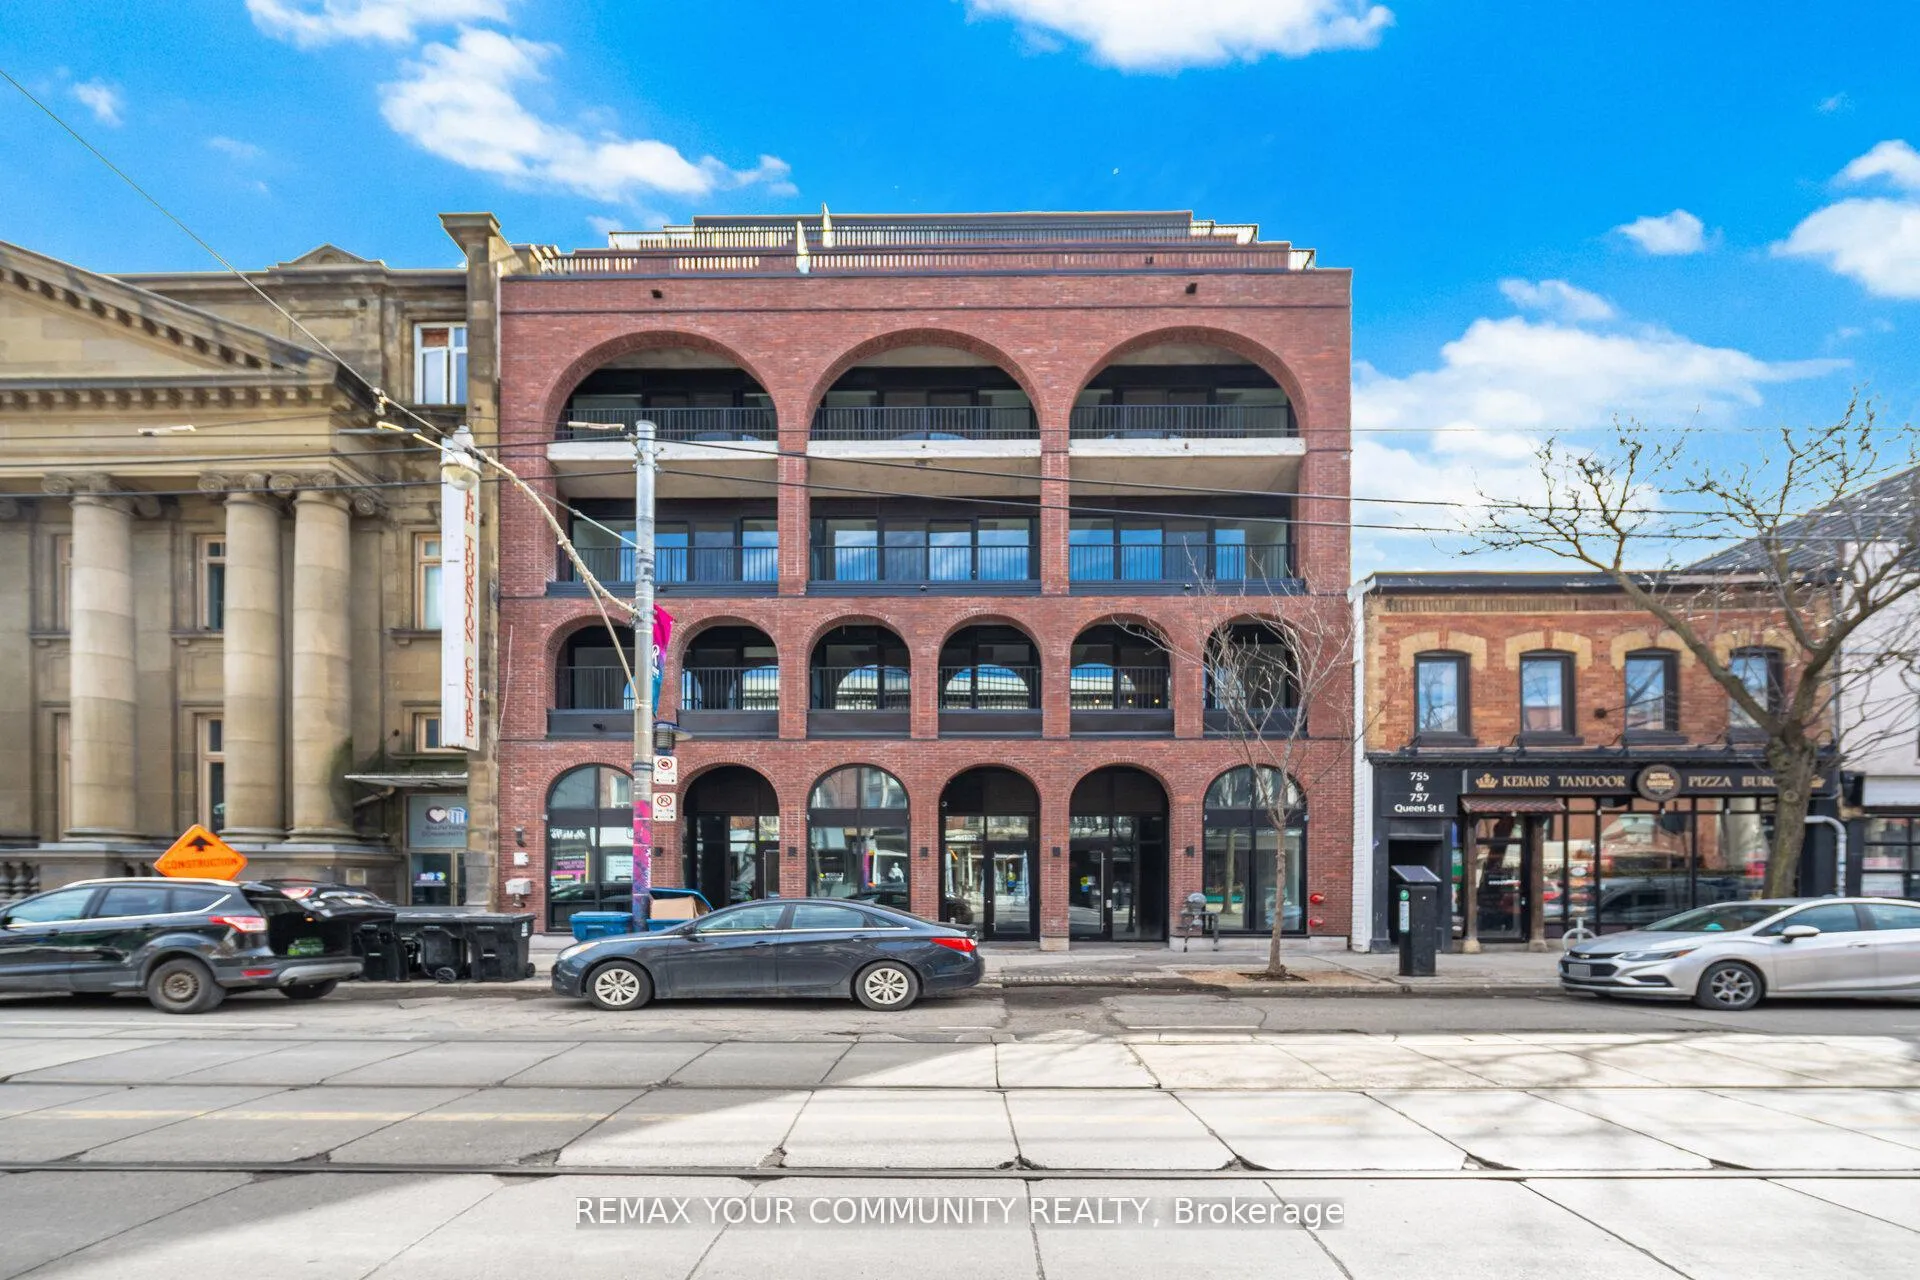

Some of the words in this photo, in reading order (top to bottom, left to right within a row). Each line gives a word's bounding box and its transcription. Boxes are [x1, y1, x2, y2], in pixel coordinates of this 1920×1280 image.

[464, 534, 475, 645] THORNTON
[464, 656, 475, 738] CENTRE
[1410, 772, 1429, 781] 755
[1503, 775, 1550, 787] KEBABS
[1557, 775, 1625, 787] TANDOOR
[1688, 776, 1732, 787] PIZZA
[1410, 793, 1429, 802] 757
[1394, 804, 1425, 813] Queen
[1428, 804, 1436, 812] St
[1438, 804, 1445, 812] E
[164, 858, 238, 870] CONSTRUCTION
